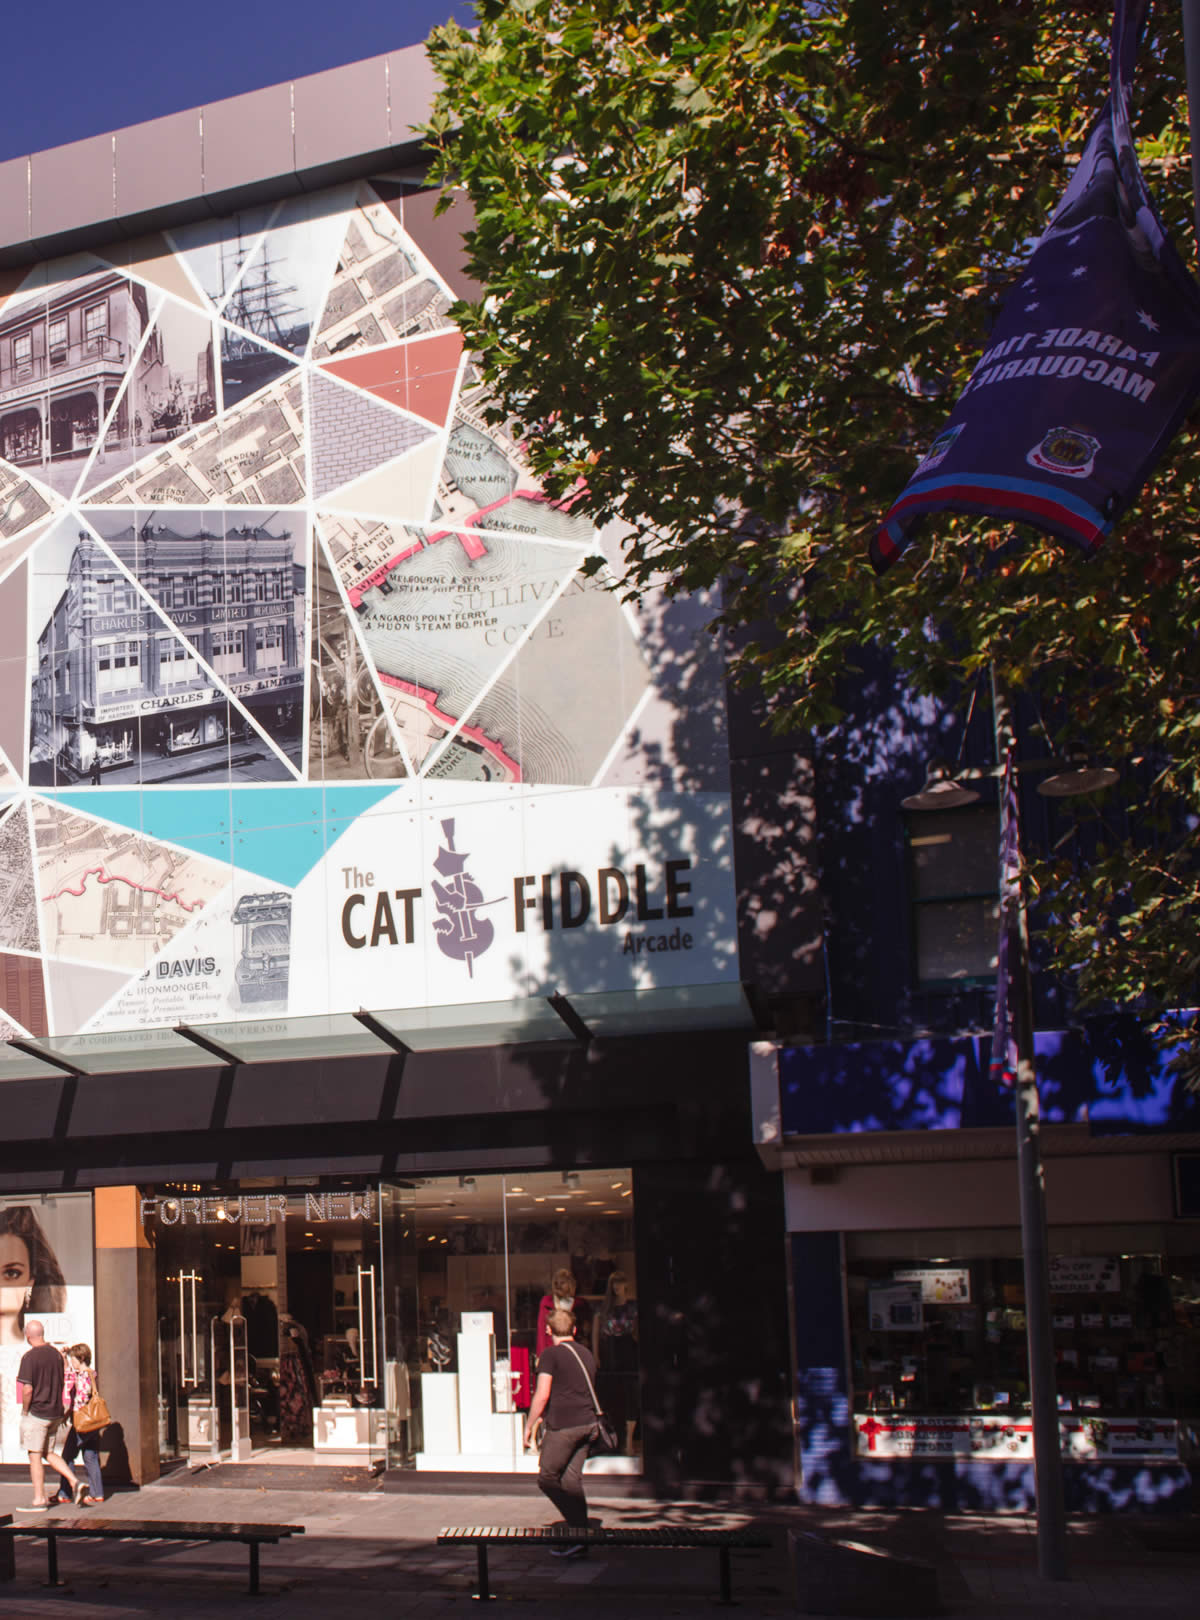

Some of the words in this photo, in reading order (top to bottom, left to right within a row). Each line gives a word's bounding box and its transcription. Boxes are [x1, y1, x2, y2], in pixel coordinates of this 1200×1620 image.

[389, 573, 447, 585] MELBOURNE
[457, 584, 482, 593] PIER
[93, 615, 145, 632] CHARLES
[162, 611, 197, 625] AVIS
[211, 607, 249, 621] LIMITED
[253, 604, 288, 617] MERCHANTS
[364, 613, 419, 623] KANGAROO
[421, 613, 453, 622] POINT
[455, 610, 488, 621] FERRY
[377, 621, 411, 631] HUON
[415, 622, 451, 631] STEAM
[473, 617, 499, 628] PIER
[140, 692, 204, 711] CHARLES
[436, 750, 467, 779] STORES
[341, 866, 375, 890] The
[341, 887, 423, 950] CAT
[513, 859, 696, 933] FIDDLE
[622, 926, 694, 956] Arcade
[156, 956, 221, 980] DAVIS,
[136, 981, 209, 996] IRONMONGER
[140, 1193, 288, 1226] FOREVER
[305, 1190, 372, 1221] NEW
